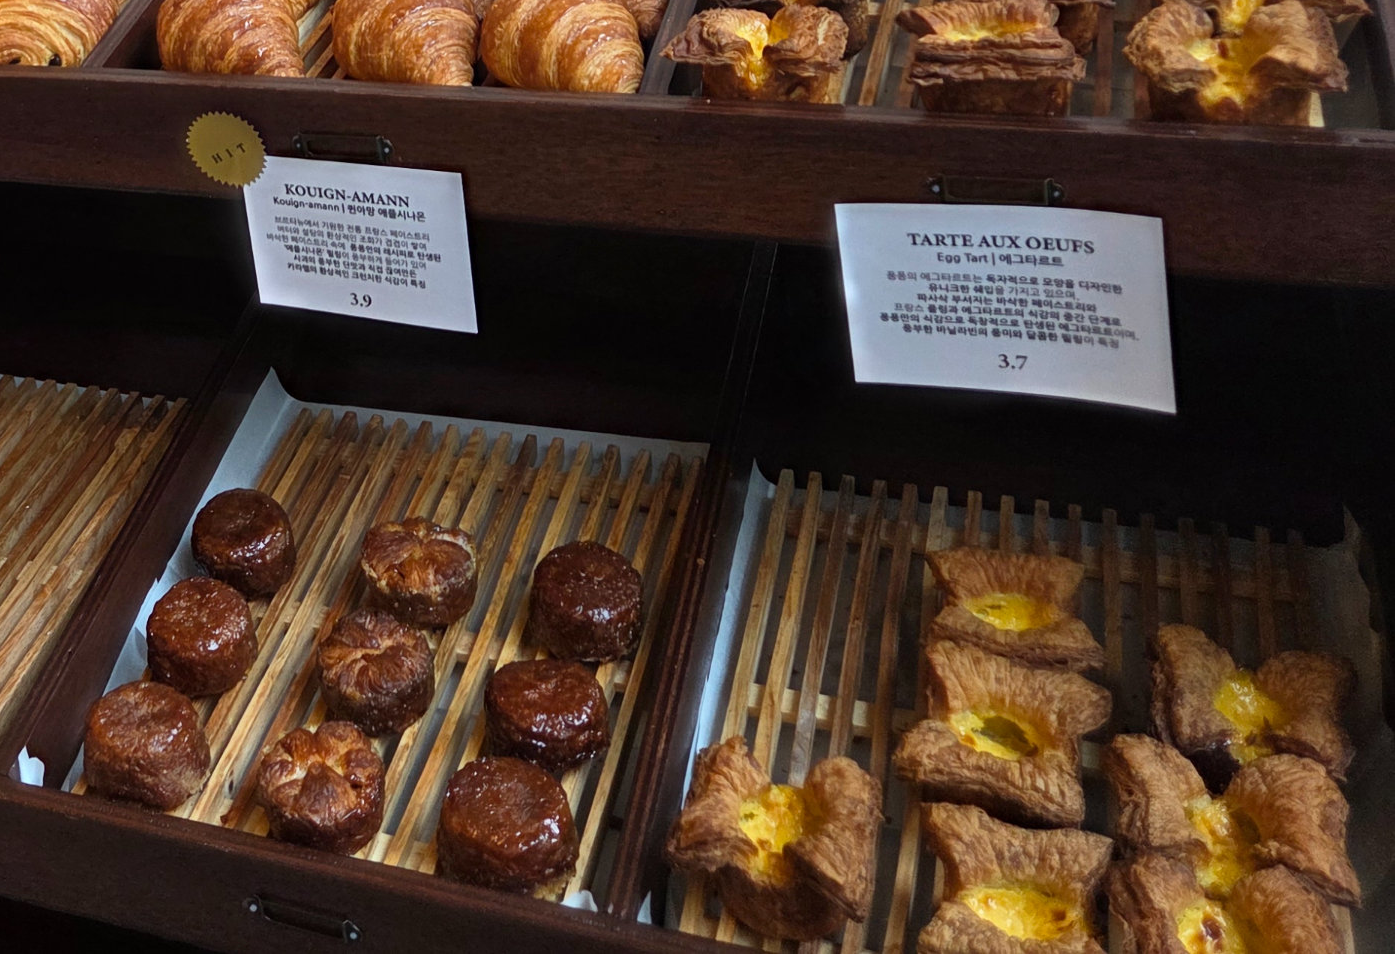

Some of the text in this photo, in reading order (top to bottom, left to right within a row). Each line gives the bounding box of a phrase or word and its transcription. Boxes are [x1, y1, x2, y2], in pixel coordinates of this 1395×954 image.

[211, 142, 246, 164] HIT
[284, 183, 410, 208] KOUIGN-AMANN
[272, 196, 340, 213] Kouign-amann
[377, 207, 426, 223] 애플시나몬
[906, 232, 1095, 254] TARTE AUX OEUFS
[936, 251, 1065, 268] Egg Tart 에그타르트
[927, 282, 971, 294] 유니크한
[1077, 280, 1123, 295] 디자인한
[350, 292, 373, 308] 3.9
[951, 294, 994, 306] 부서지는
[995, 296, 1029, 308] 바삭한
[1031, 298, 1098, 314] 페이스트리와
[935, 323, 988, 338] 바닐라빈의
[998, 353, 1028, 370] 3.7
